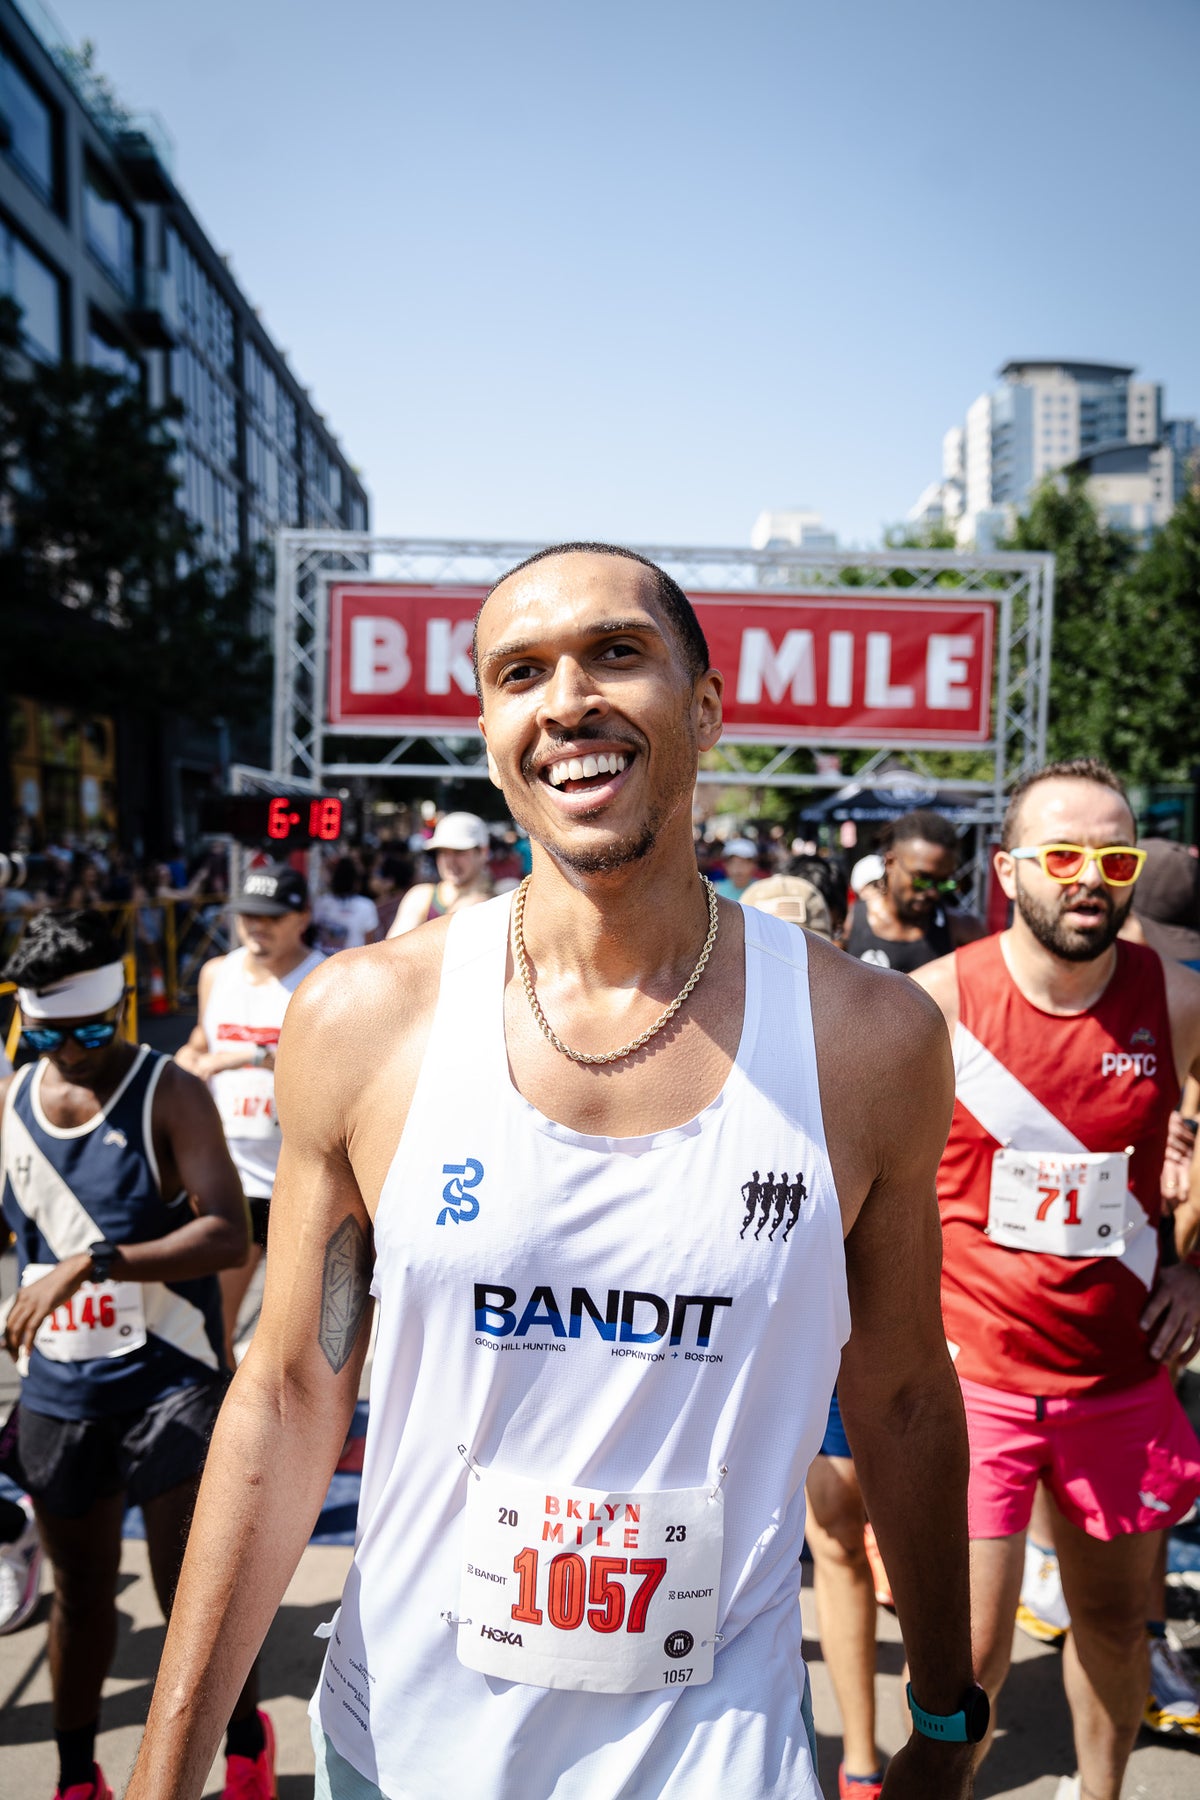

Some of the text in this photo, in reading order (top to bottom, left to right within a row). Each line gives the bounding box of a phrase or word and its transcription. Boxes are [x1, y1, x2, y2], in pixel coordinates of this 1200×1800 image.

[349, 615, 975, 712] BK MILE
[1101, 1052, 1157, 1077] PPTC
[1036, 1186, 1082, 1226] 71
[473, 1283, 733, 1349] BANDIT
[474, 1337, 566, 1352] GOOD HILL HUNTING
[611, 1348, 723, 1363] HOPKINTON BOSTON
[498, 1507, 519, 1527] 20
[545, 1495, 641, 1523] BKLYN
[541, 1521, 640, 1549] MILE
[665, 1525, 686, 1542] 23
[475, 1568, 507, 1585] BANDIT
[511, 1546, 667, 1634] 1057
[677, 1588, 714, 1600] BANDIT
[480, 1624, 524, 1647] HOKA
[663, 1668, 693, 1684] 1057
